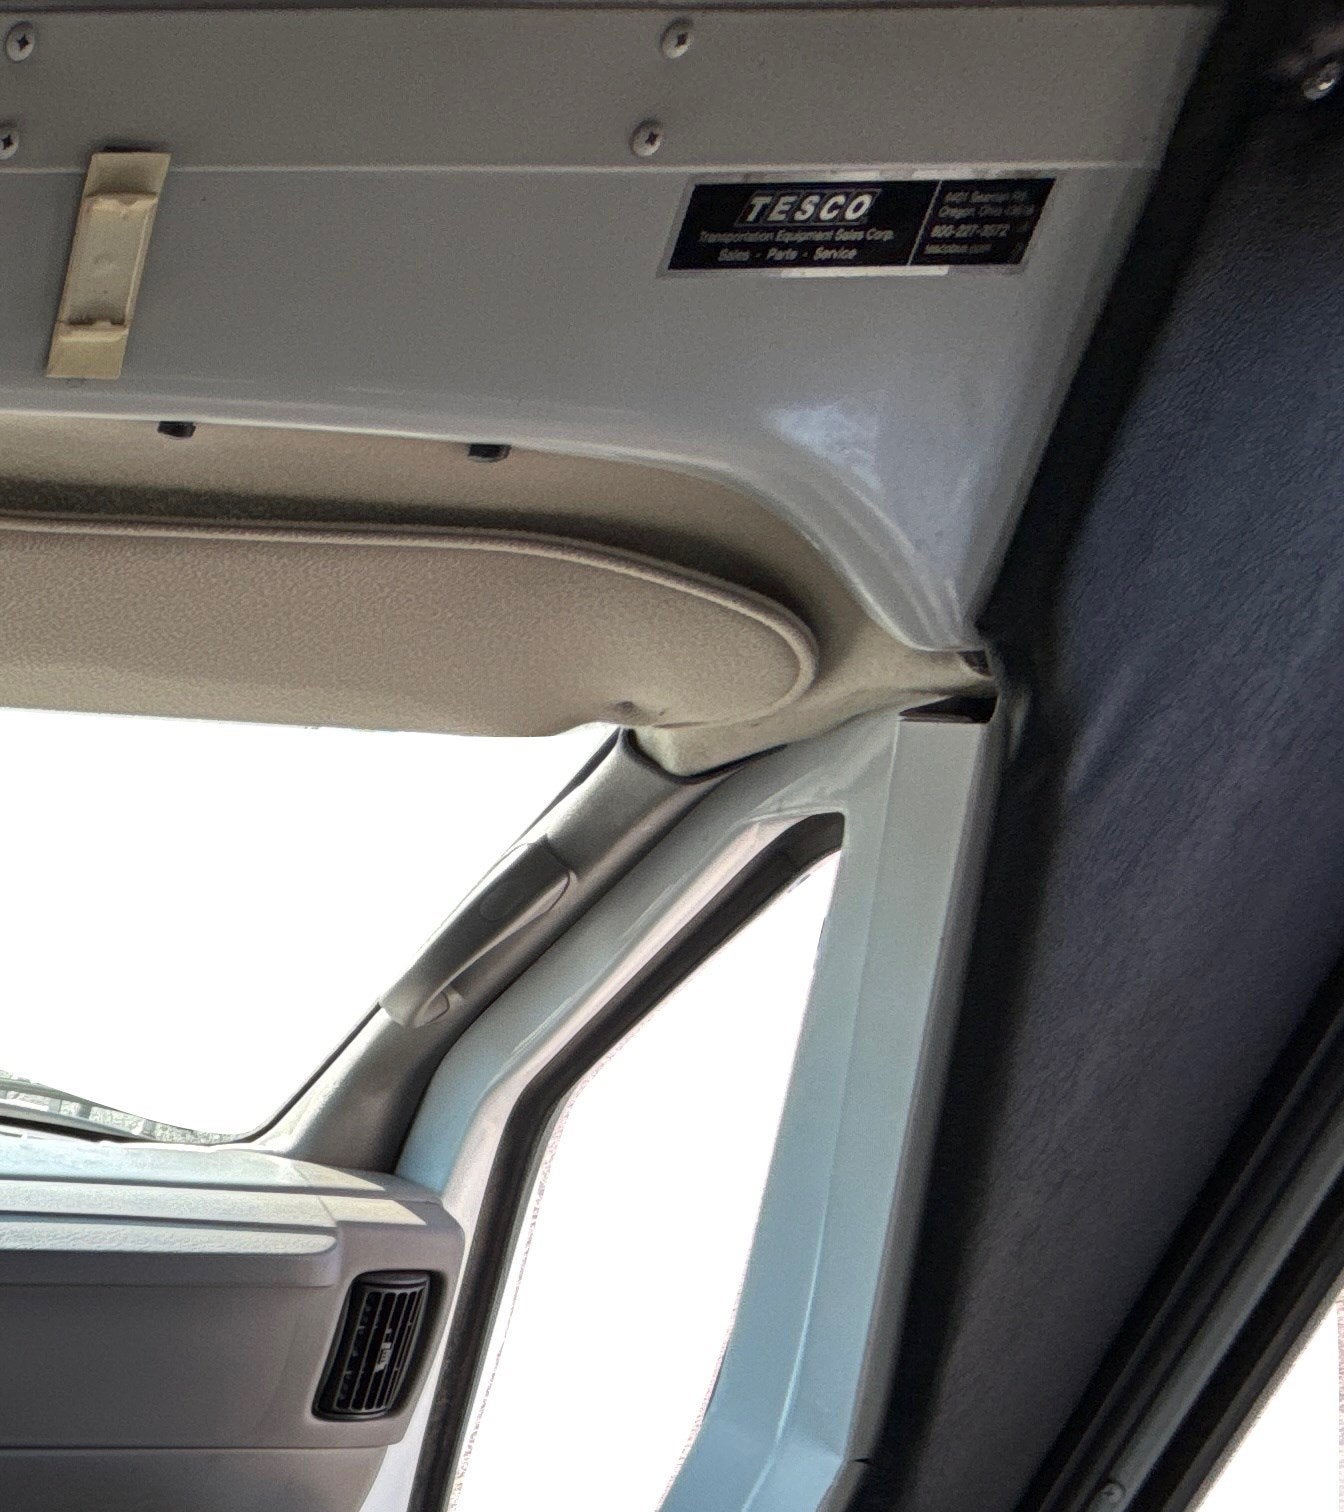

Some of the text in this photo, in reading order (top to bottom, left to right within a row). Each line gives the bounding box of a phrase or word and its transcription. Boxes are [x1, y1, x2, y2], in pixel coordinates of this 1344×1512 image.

[746, 195, 872, 222] TESCO
[717, 248, 750, 261] Sales
[767, 247, 798, 261] Parts
[813, 246, 858, 260] Service
